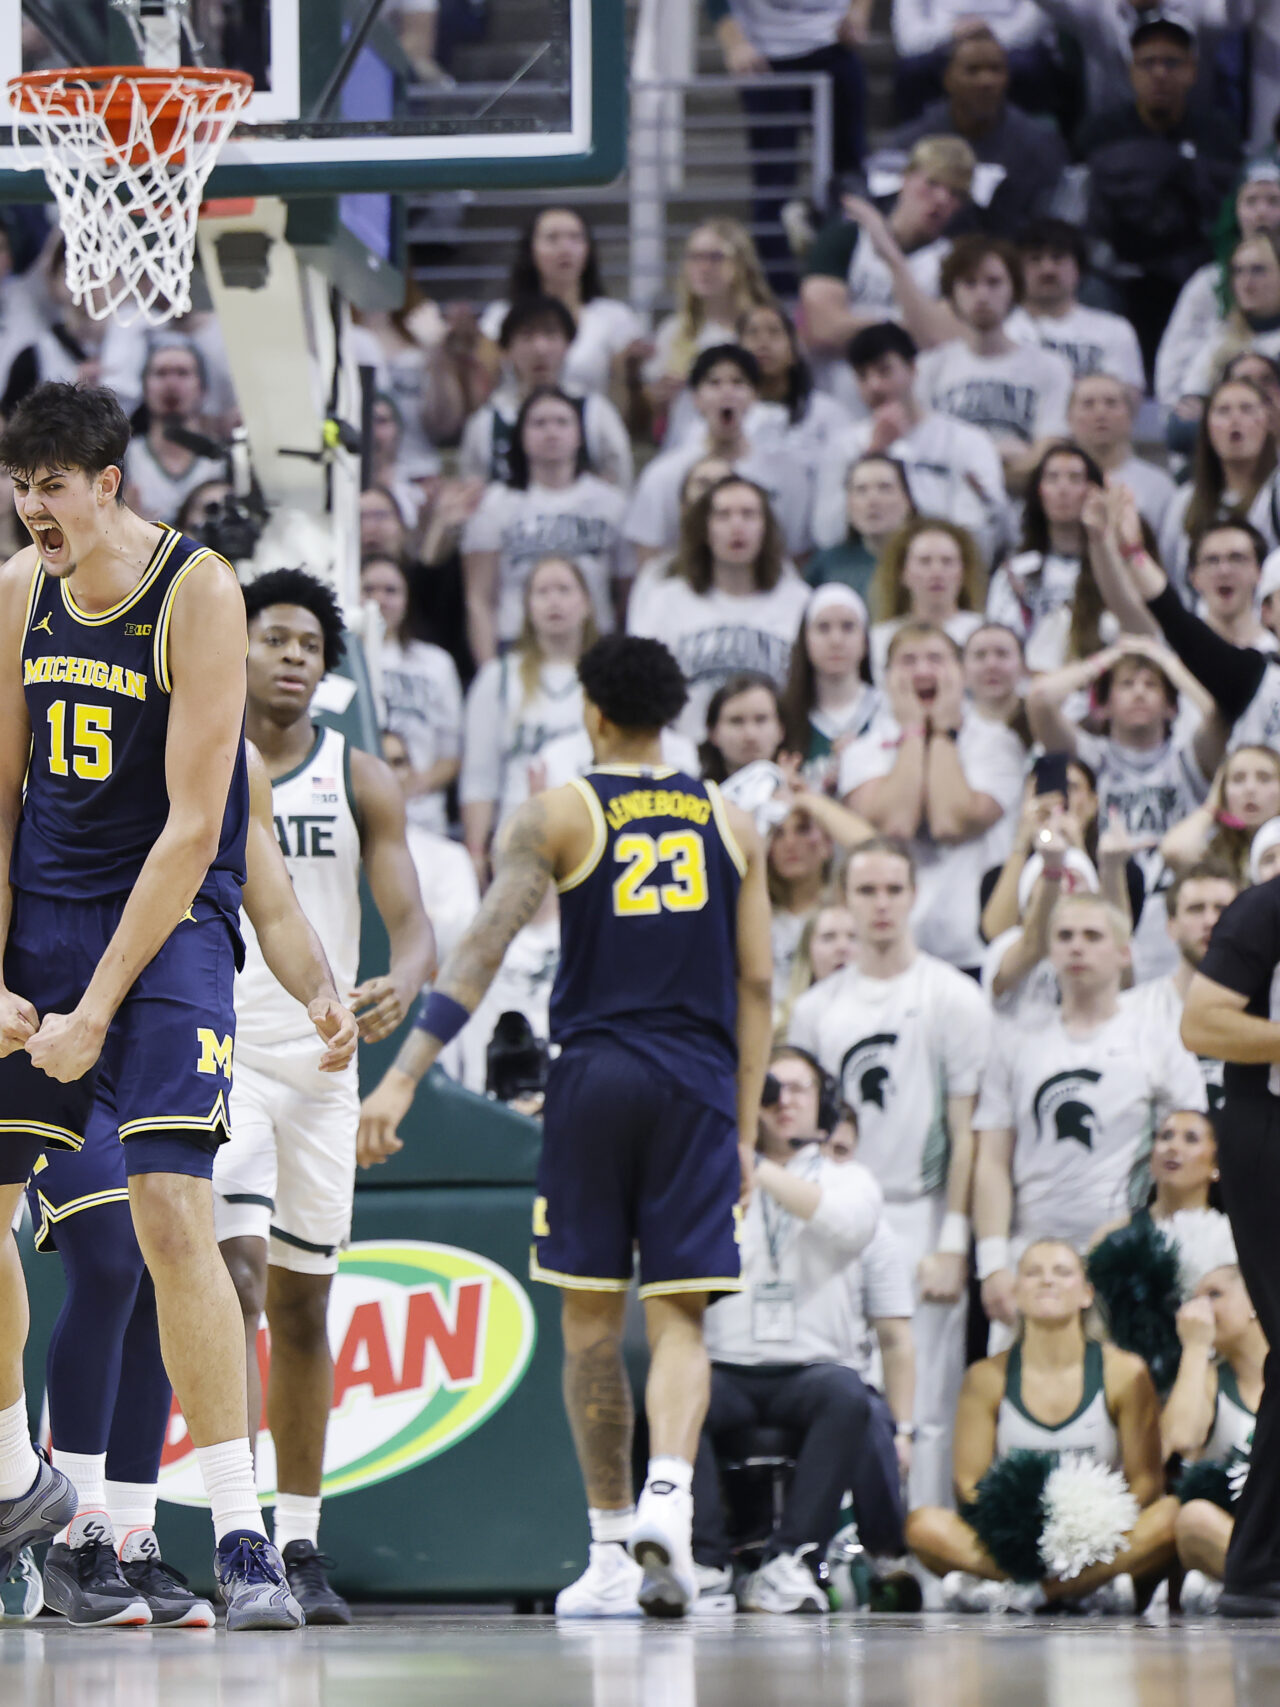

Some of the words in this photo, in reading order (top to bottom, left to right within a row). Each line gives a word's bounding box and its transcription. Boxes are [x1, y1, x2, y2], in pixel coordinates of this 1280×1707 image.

[23, 655, 147, 701] MICHIGAN
[47, 699, 112, 781] 15
[273, 815, 337, 857] ATE
[612, 829, 709, 916] 23
[196, 1027, 233, 1083] M
